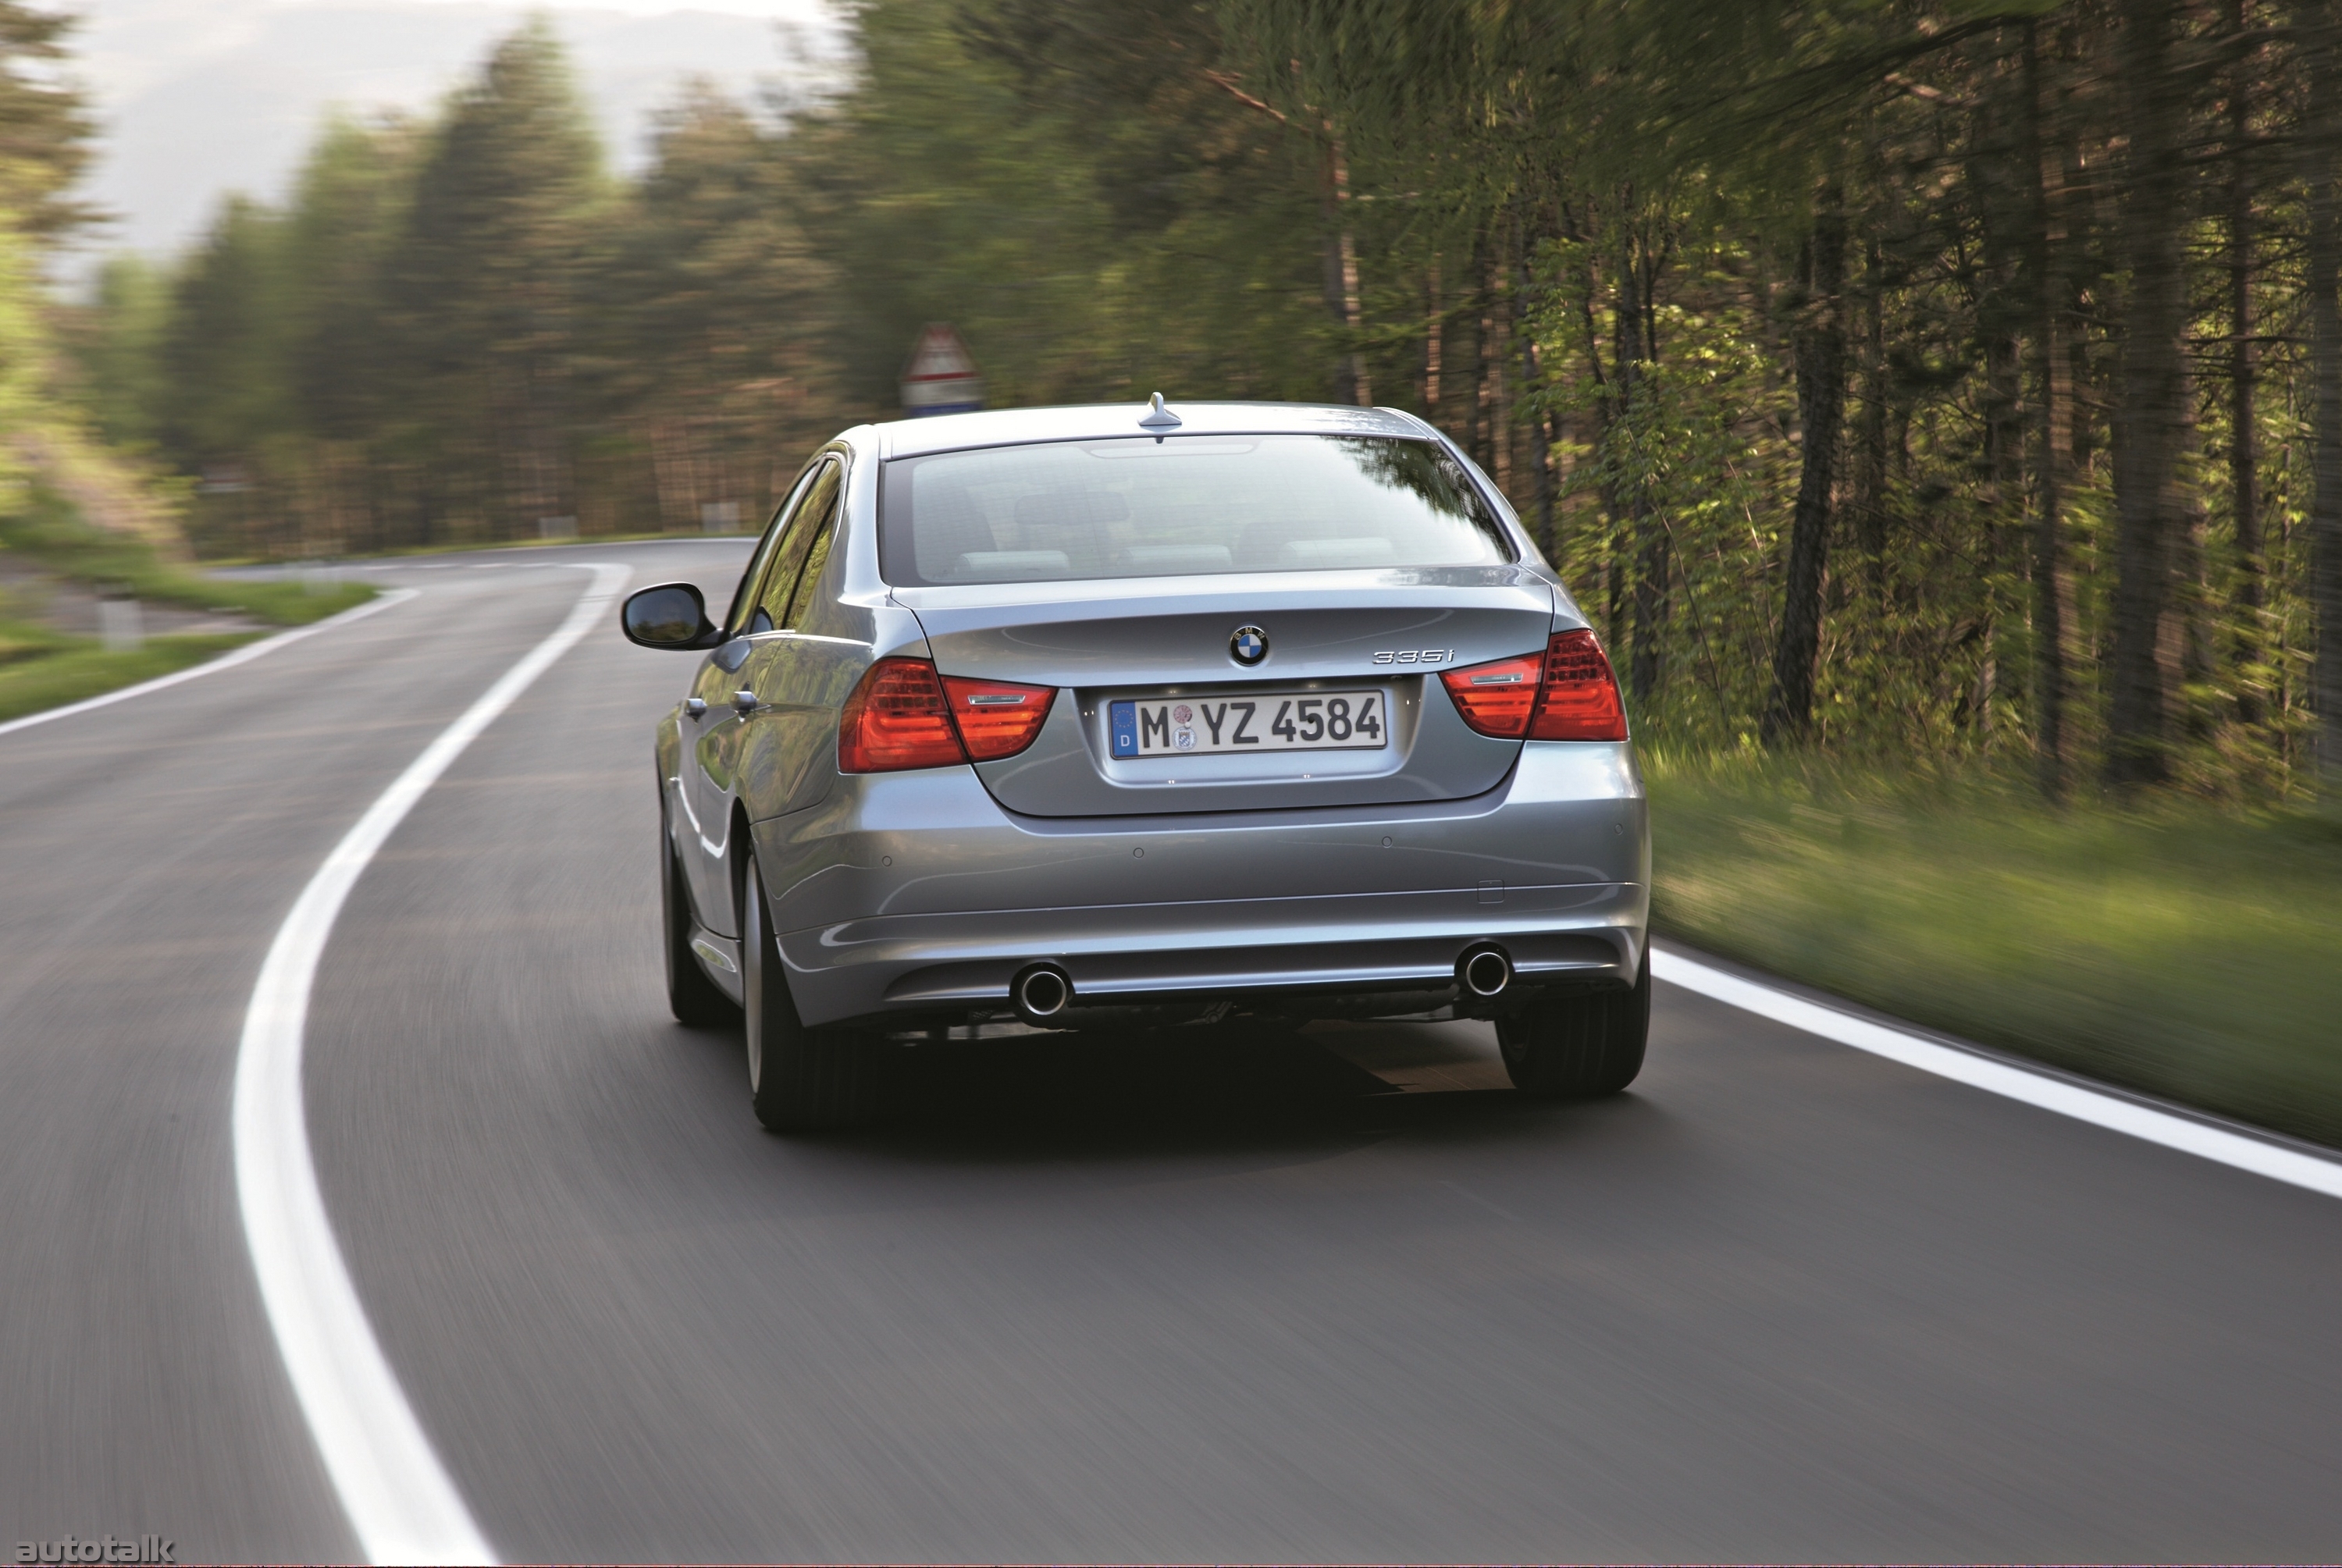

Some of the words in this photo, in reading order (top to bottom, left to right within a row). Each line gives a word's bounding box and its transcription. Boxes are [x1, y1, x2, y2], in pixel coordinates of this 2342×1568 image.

[1234, 628, 1265, 640] BMW
[1372, 649, 1454, 664] 335i
[1141, 706, 1170, 748] M
[1201, 702, 1259, 745] YZ
[1272, 698, 1380, 741] 4584
[1120, 734, 1130, 747] D
